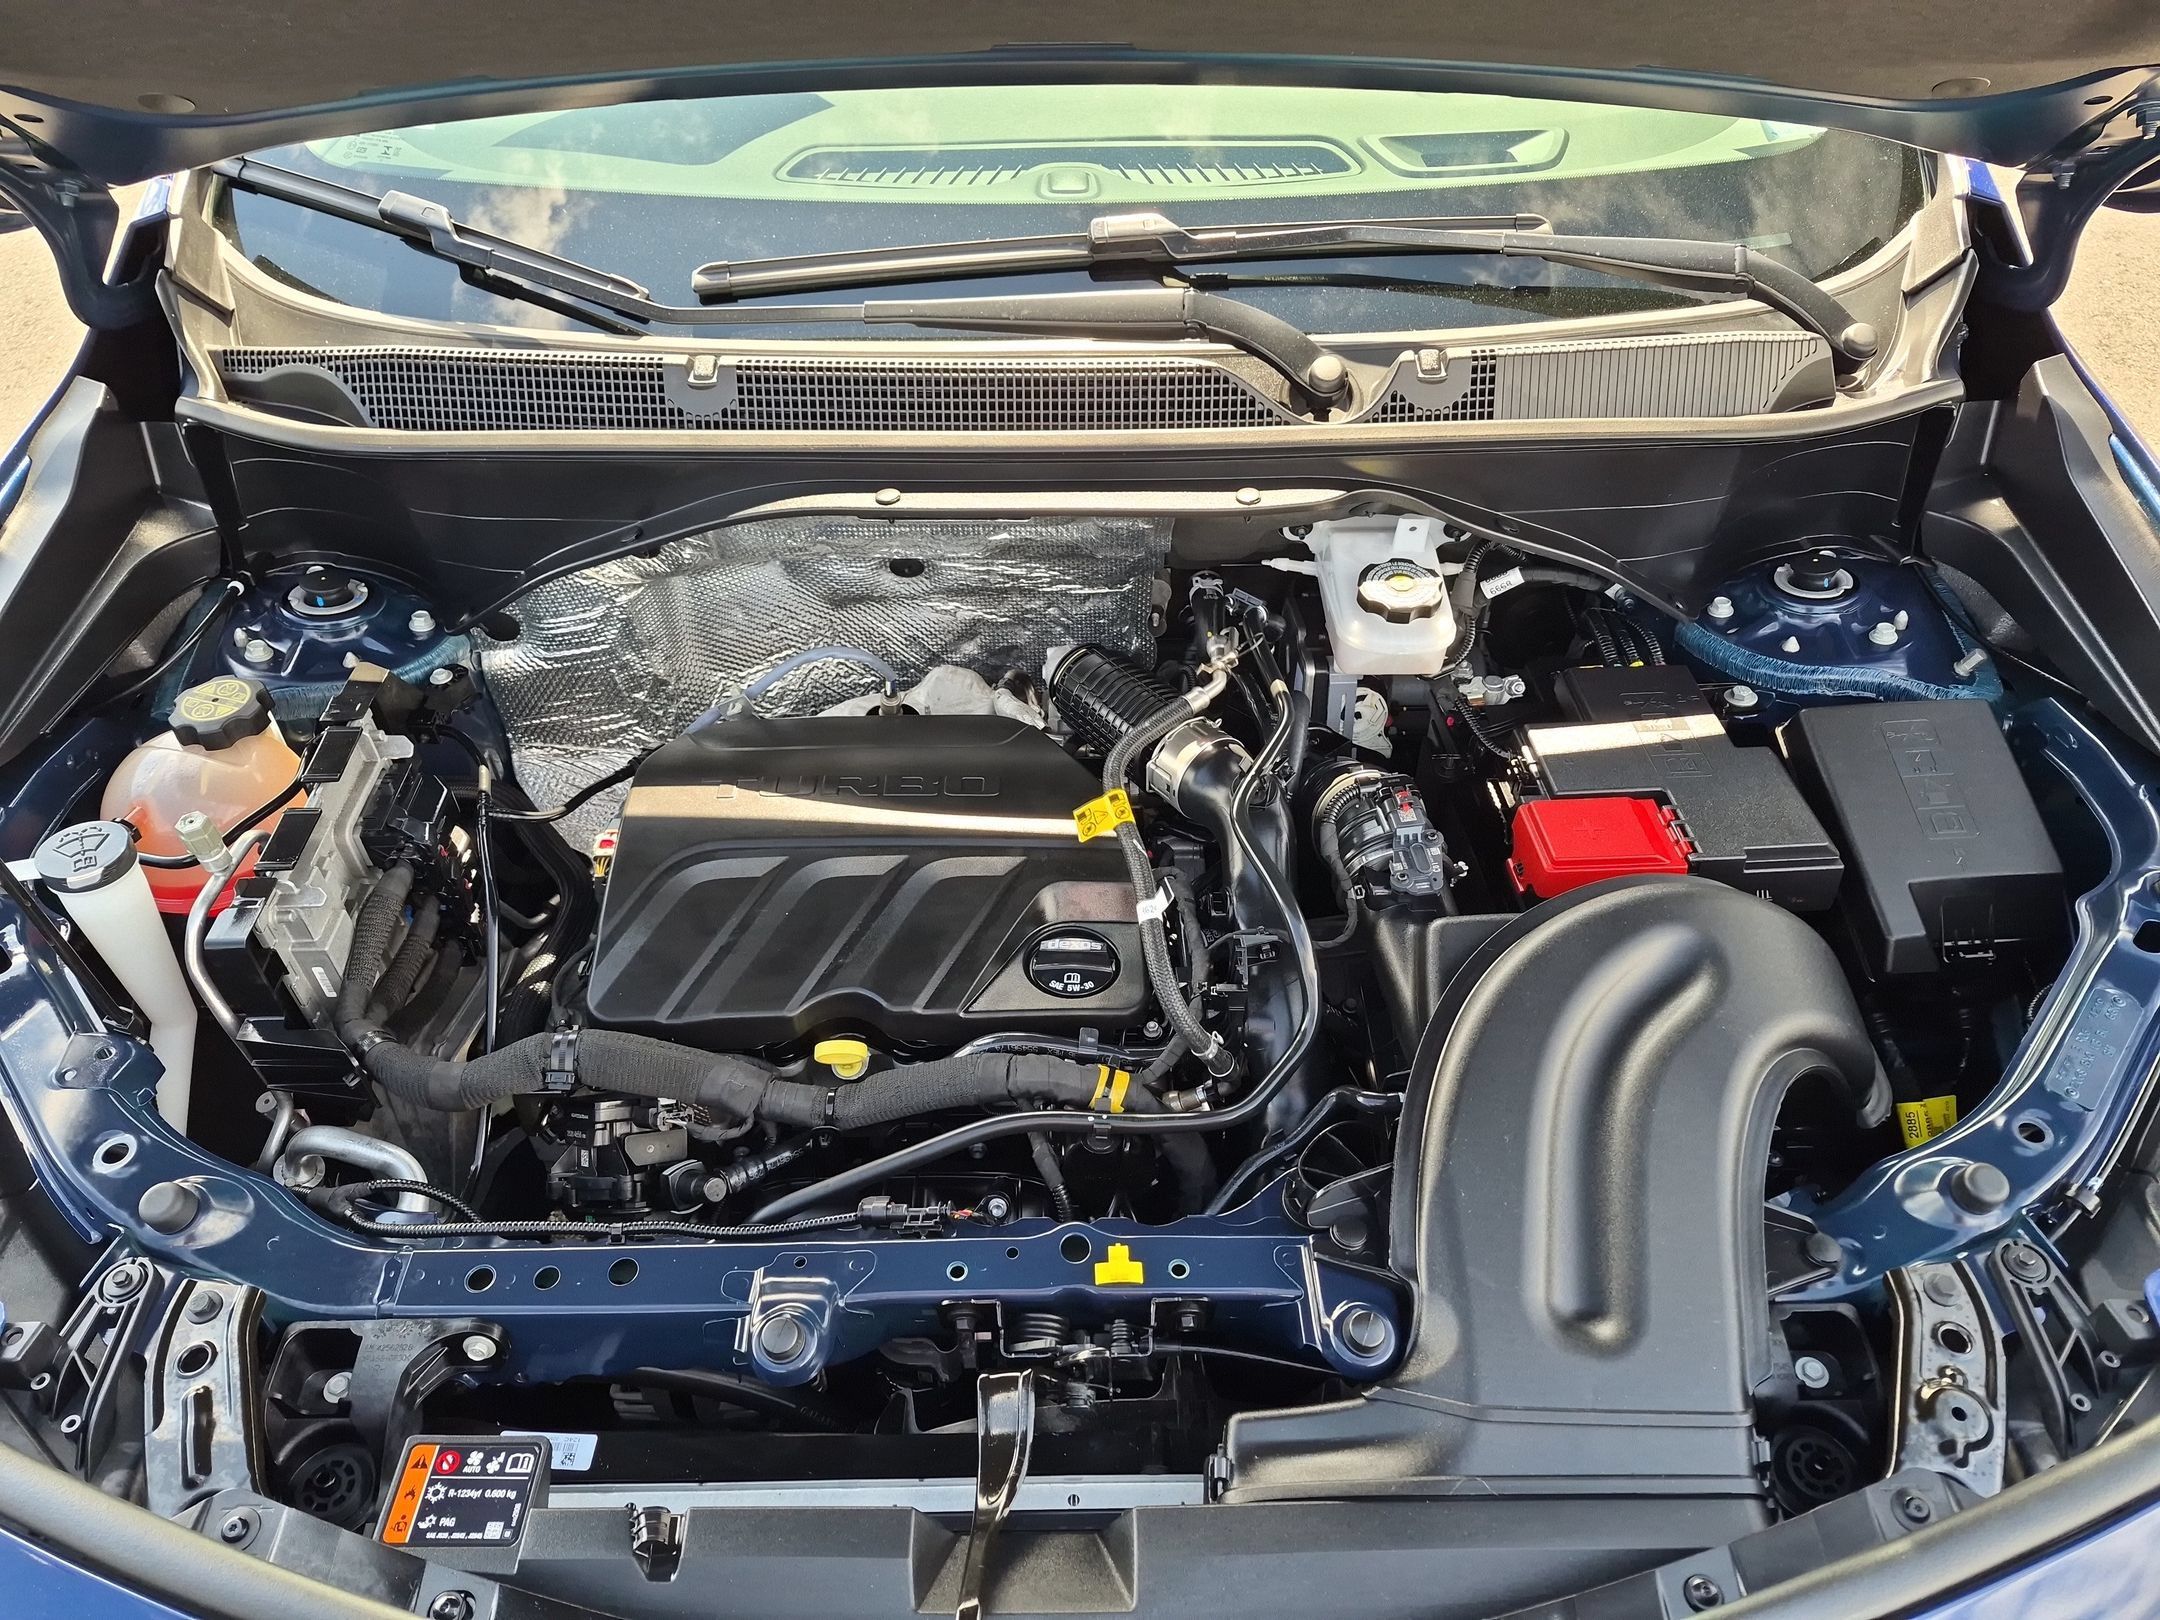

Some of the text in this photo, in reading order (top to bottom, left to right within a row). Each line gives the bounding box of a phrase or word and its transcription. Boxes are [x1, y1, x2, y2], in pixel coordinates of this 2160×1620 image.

[702, 775, 1000, 799] TURBO
[1047, 939, 1102, 951] dexos
[1049, 980, 1094, 992] SAE 5W-30
[1905, 1111, 1919, 1139] 2885
[463, 1465, 481, 1474] AUTO
[485, 1488, 506, 1498] 0.600
[506, 1489, 517, 1500] kg
[439, 1517, 456, 1527] PAG
